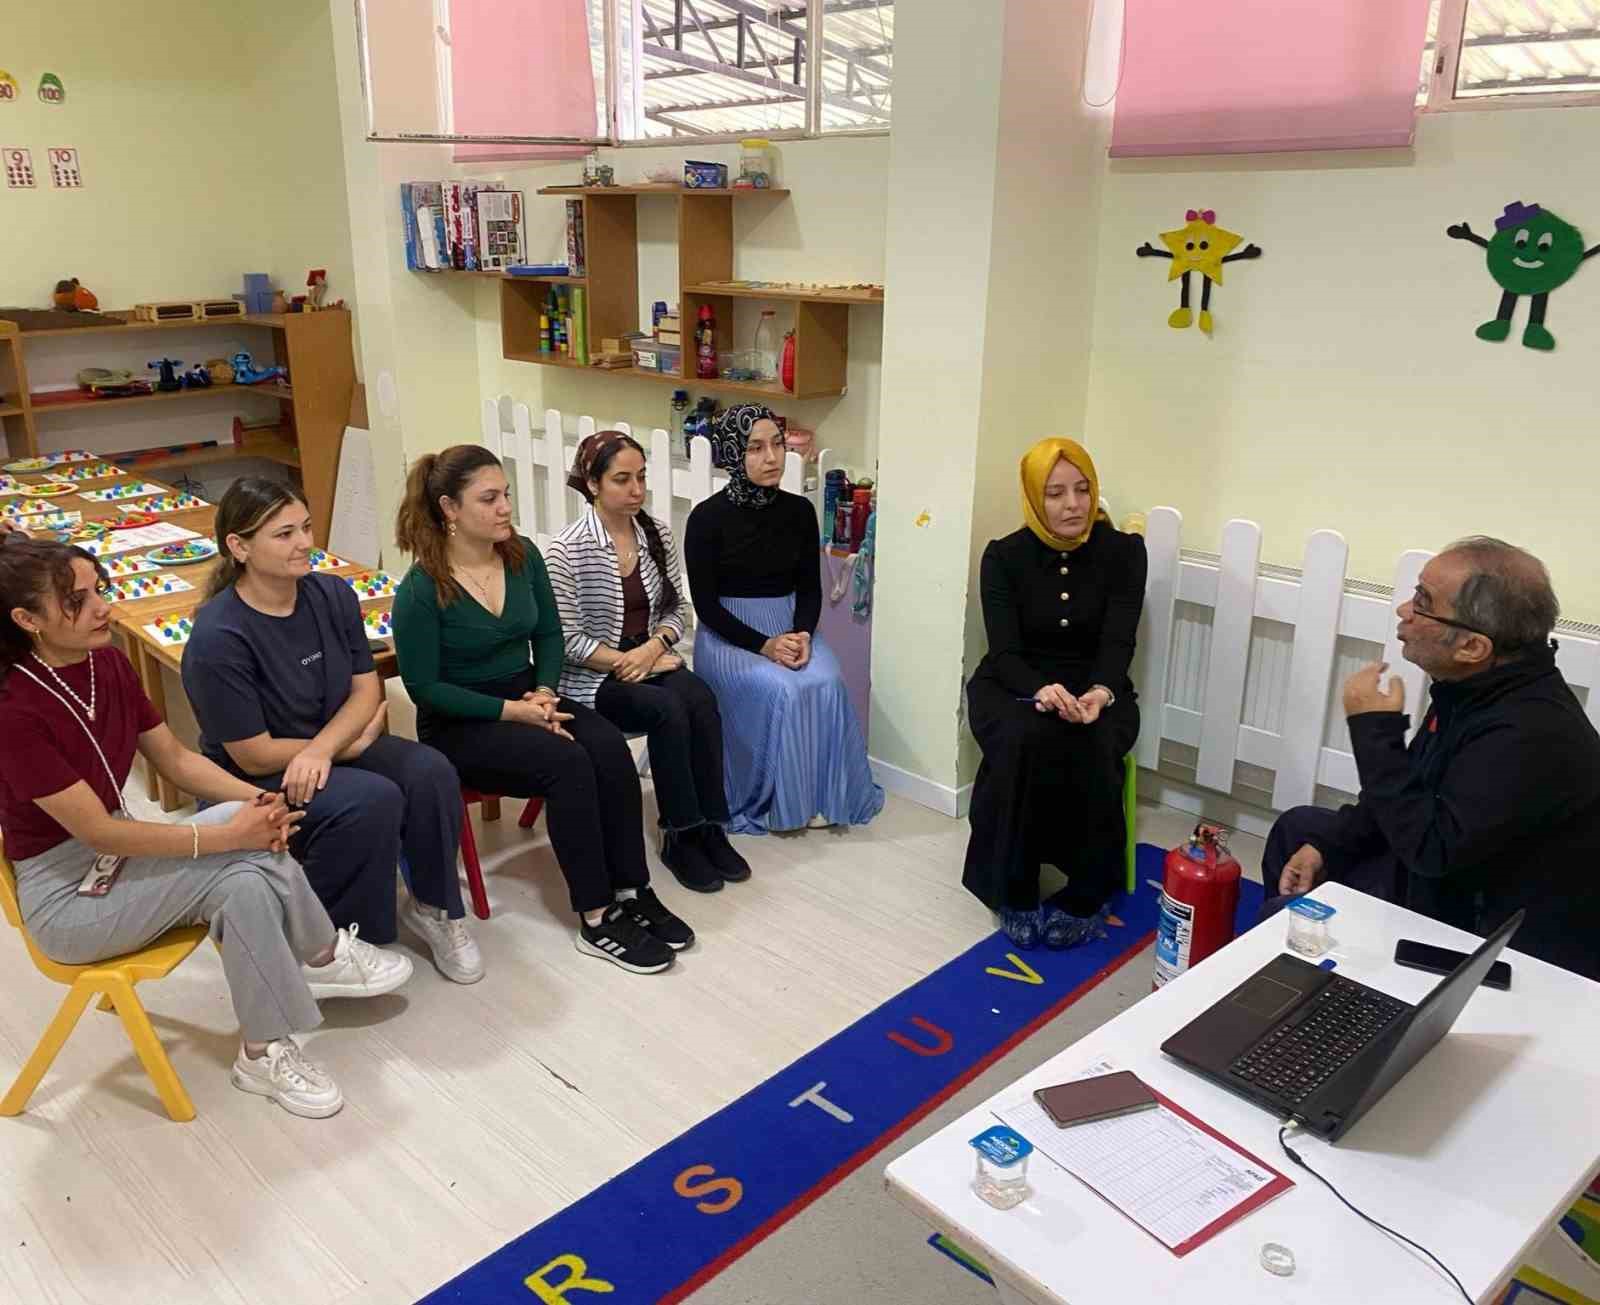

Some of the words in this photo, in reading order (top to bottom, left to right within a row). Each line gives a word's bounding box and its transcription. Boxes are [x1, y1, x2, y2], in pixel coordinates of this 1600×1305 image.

[42, 87, 60, 100] 100
[12, 151, 23, 166] 9
[54, 150, 71, 162] 10
[524, 1253, 615, 1305] R
[673, 1164, 743, 1214] S
[788, 1081, 854, 1123] T
[890, 1016, 953, 1056] U
[985, 953, 1044, 985] V
